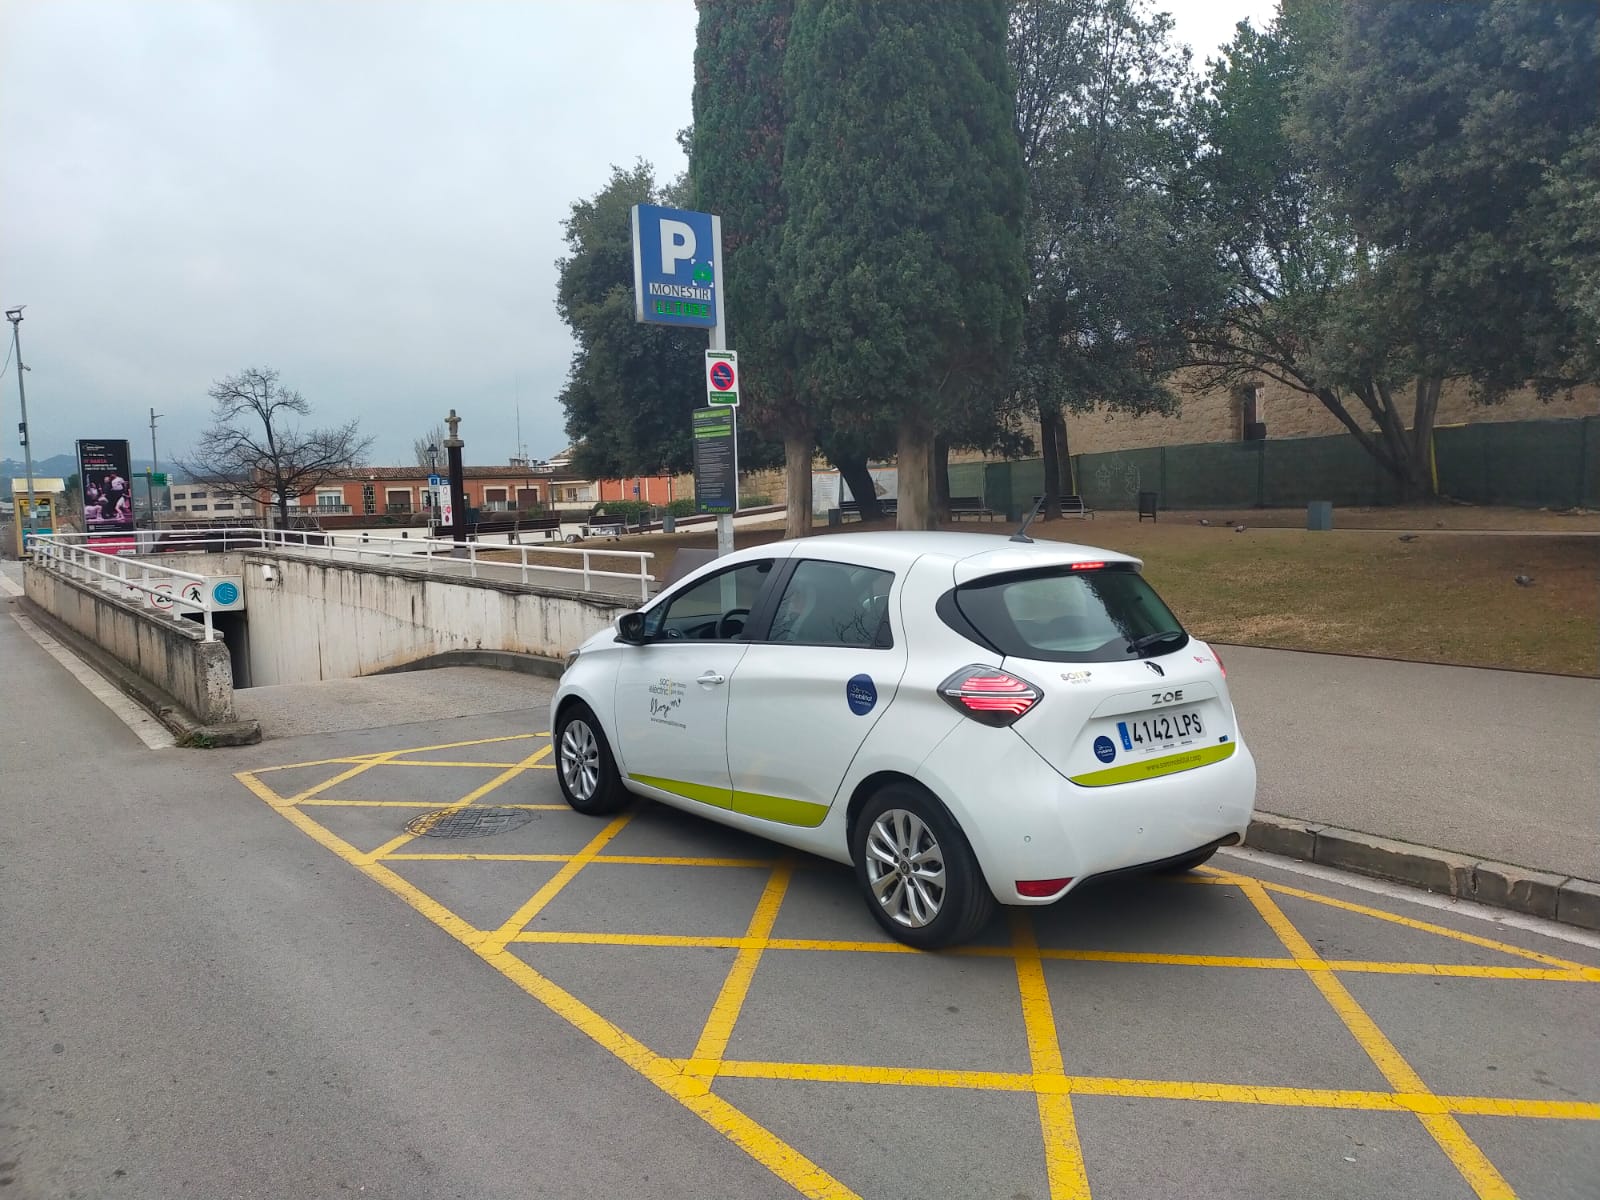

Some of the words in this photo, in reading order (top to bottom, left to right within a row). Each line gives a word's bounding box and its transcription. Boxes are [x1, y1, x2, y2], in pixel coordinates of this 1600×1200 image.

[660, 218, 697, 275] P
[651, 284, 709, 299] MONESTIR
[1152, 690, 1184, 705] ZOE
[1133, 718, 1173, 744] 4142
[1173, 713, 1203, 737] LPS
